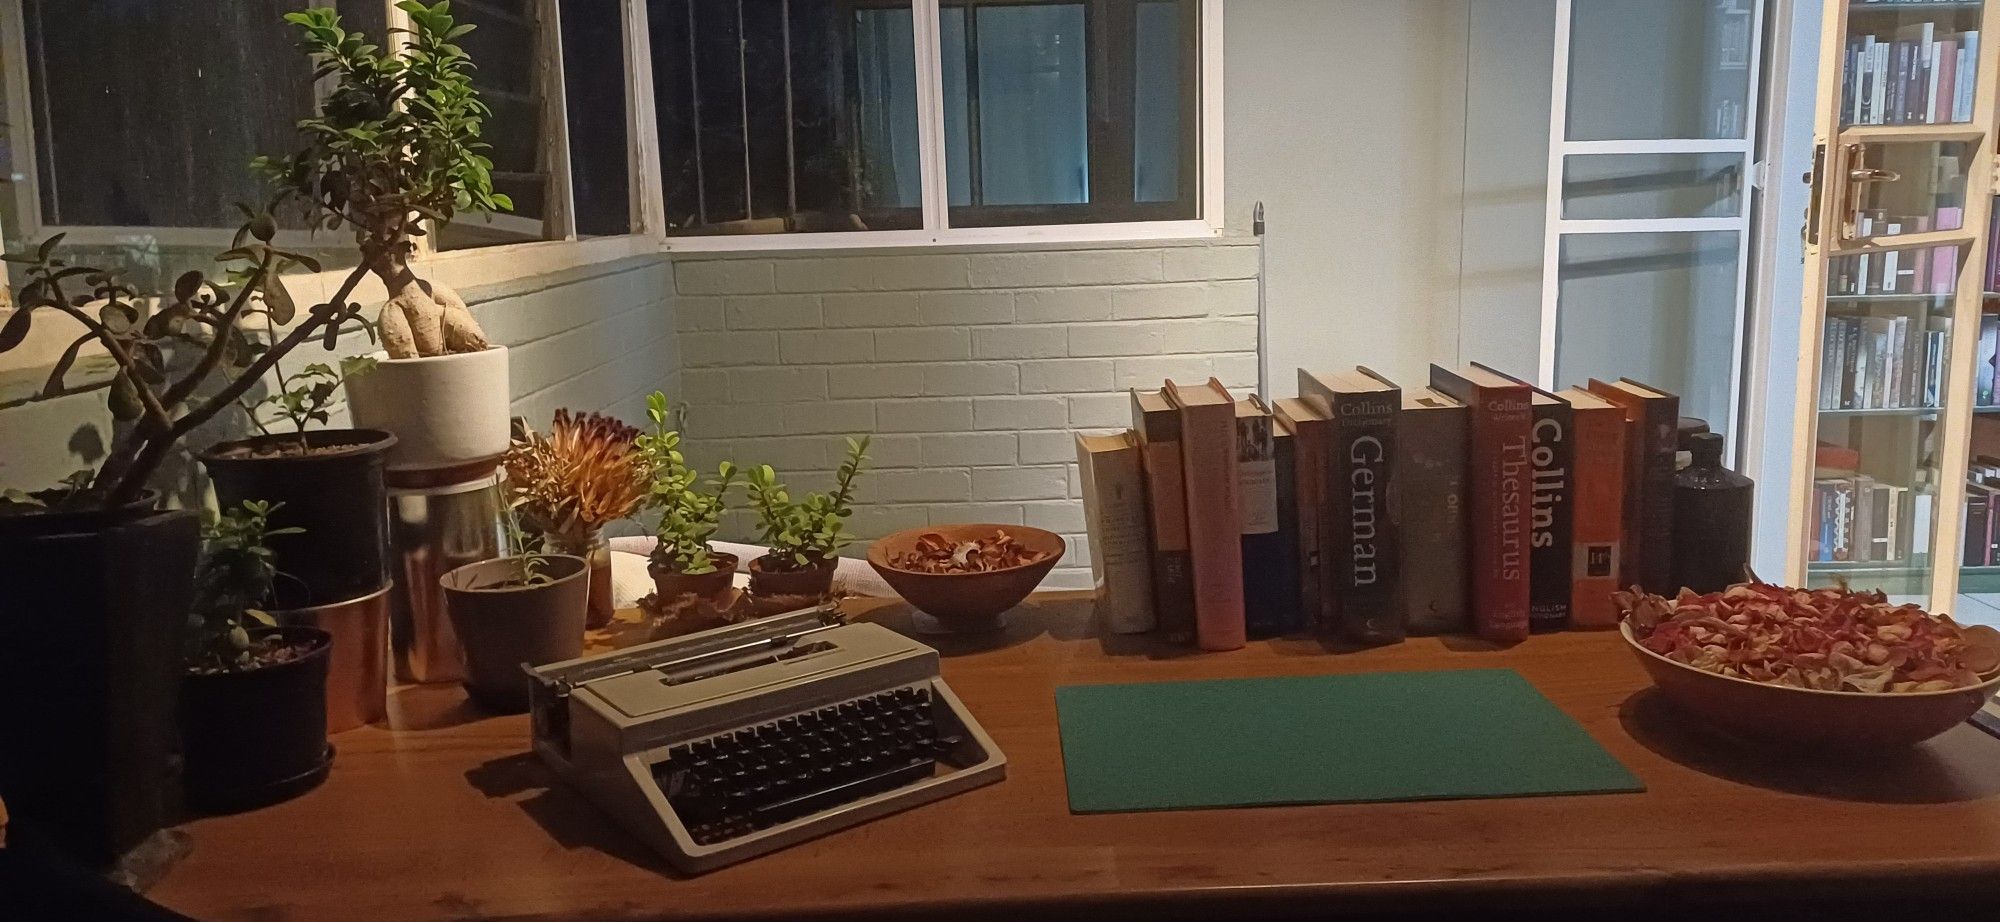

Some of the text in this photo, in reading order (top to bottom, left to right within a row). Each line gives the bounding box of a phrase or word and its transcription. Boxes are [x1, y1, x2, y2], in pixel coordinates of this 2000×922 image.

[1340, 401, 1393, 416] Collins
[1488, 399, 1530, 412] Collins
[1350, 435, 1384, 587] German
[1502, 435, 1527, 581] Thesaurus
[1531, 417, 1565, 549] Collins
